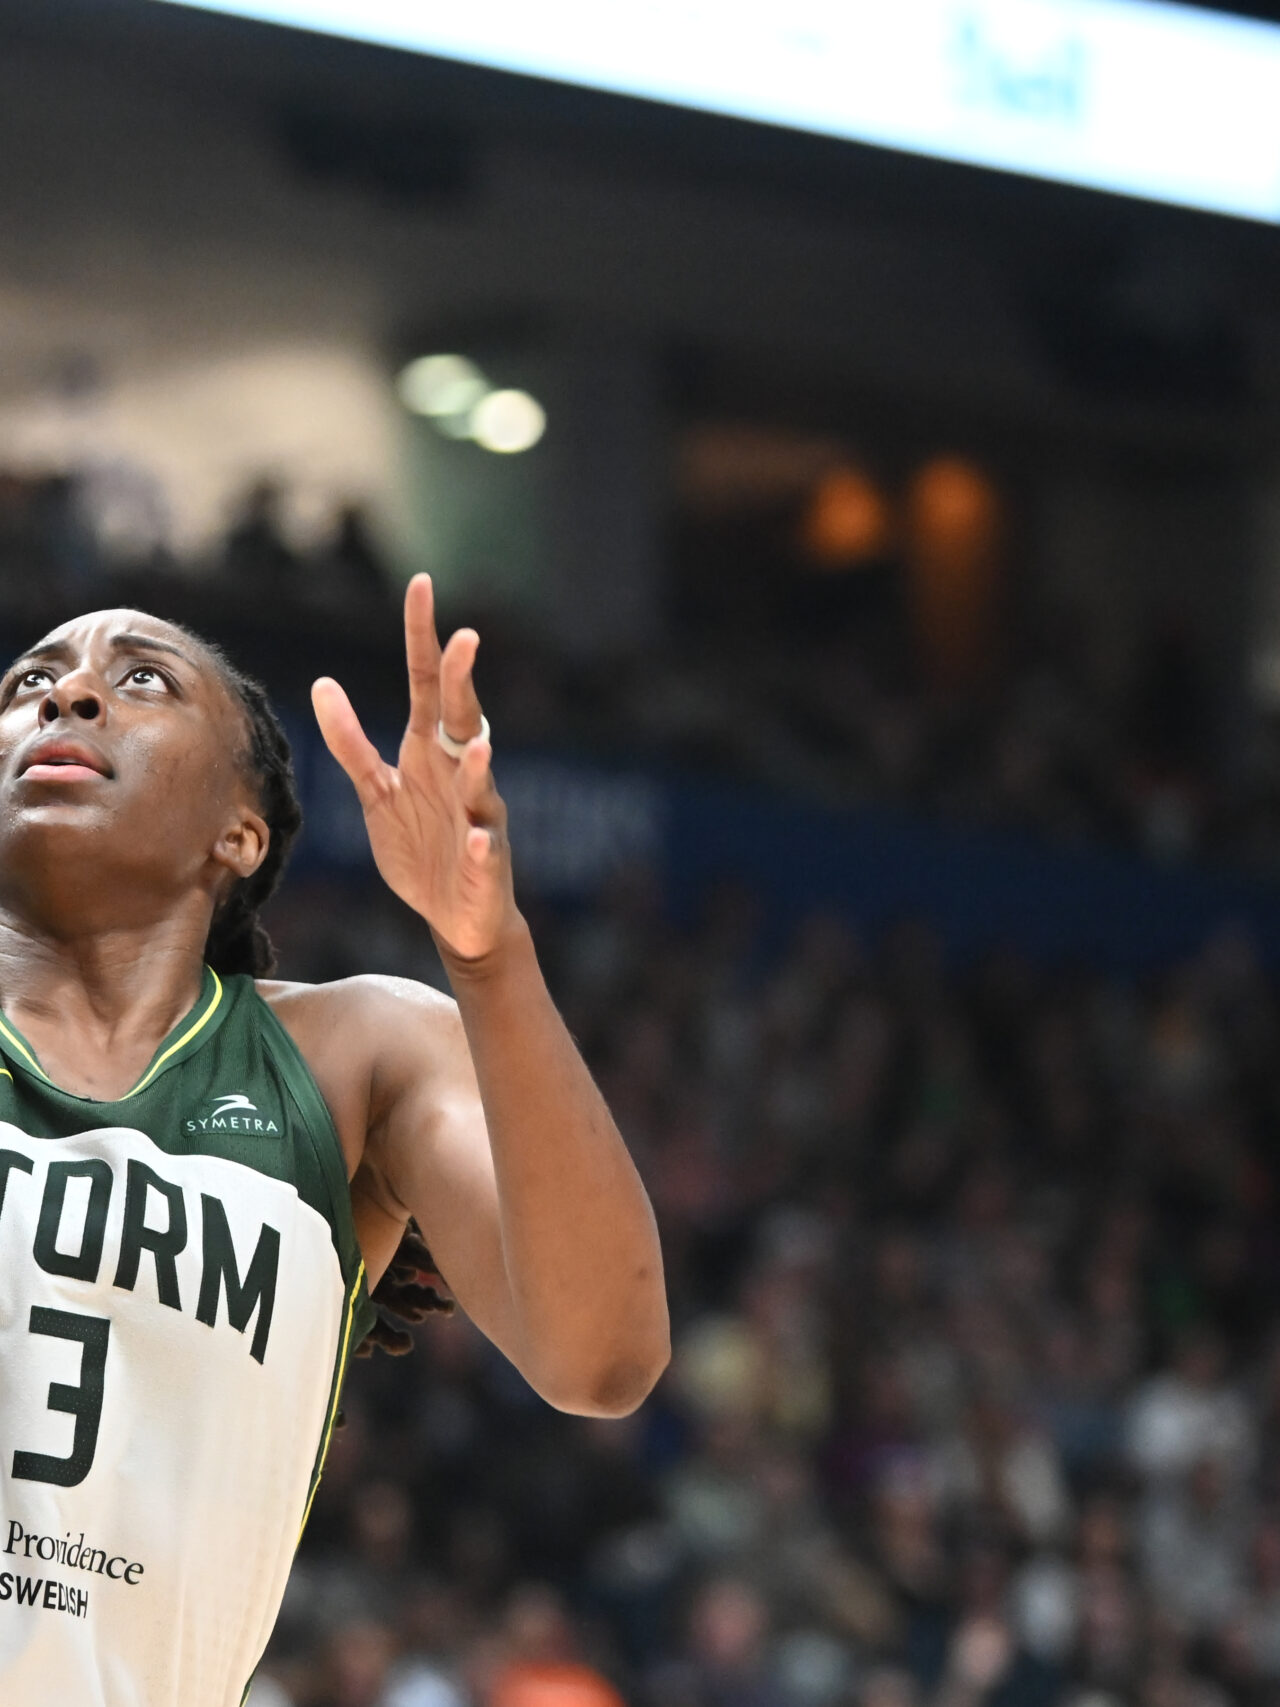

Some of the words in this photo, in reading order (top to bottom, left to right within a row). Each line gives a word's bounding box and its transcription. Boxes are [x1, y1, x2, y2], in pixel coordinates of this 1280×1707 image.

[186, 1116, 279, 1132] SYMETRA
[11, 1305, 111, 1488] 3
[2, 1520, 144, 1585] Providence
